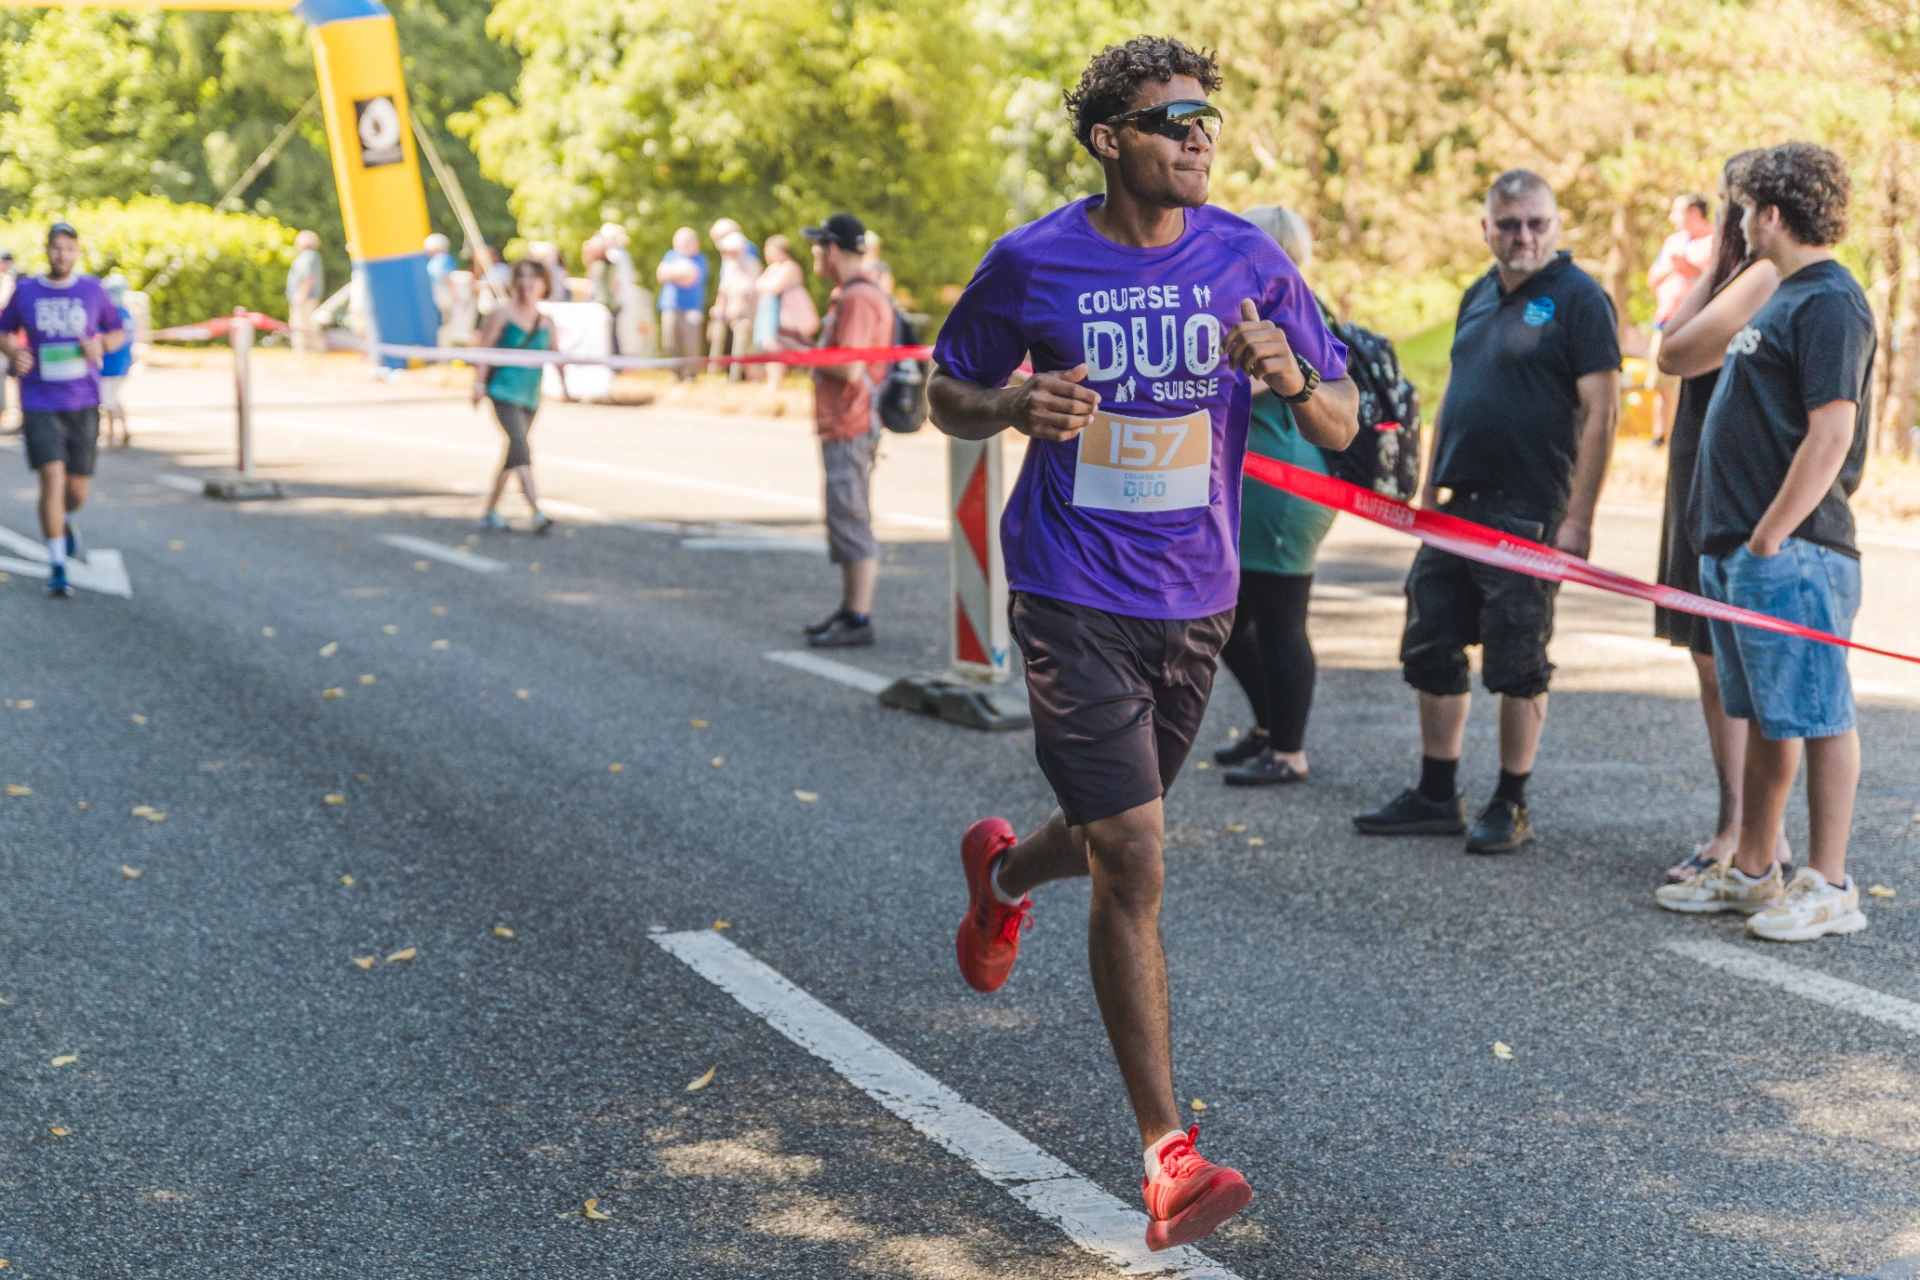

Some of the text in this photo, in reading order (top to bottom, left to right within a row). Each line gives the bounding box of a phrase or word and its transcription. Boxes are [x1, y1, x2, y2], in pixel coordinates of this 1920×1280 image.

[1078, 285, 1180, 315] COURSE
[1083, 313, 1220, 381] DUO
[1152, 378, 1219, 402] SUISSE
[1109, 421, 1189, 467] 157
[1123, 481, 1167, 498] DUO
[1124, 472, 1155, 480] COURSE
